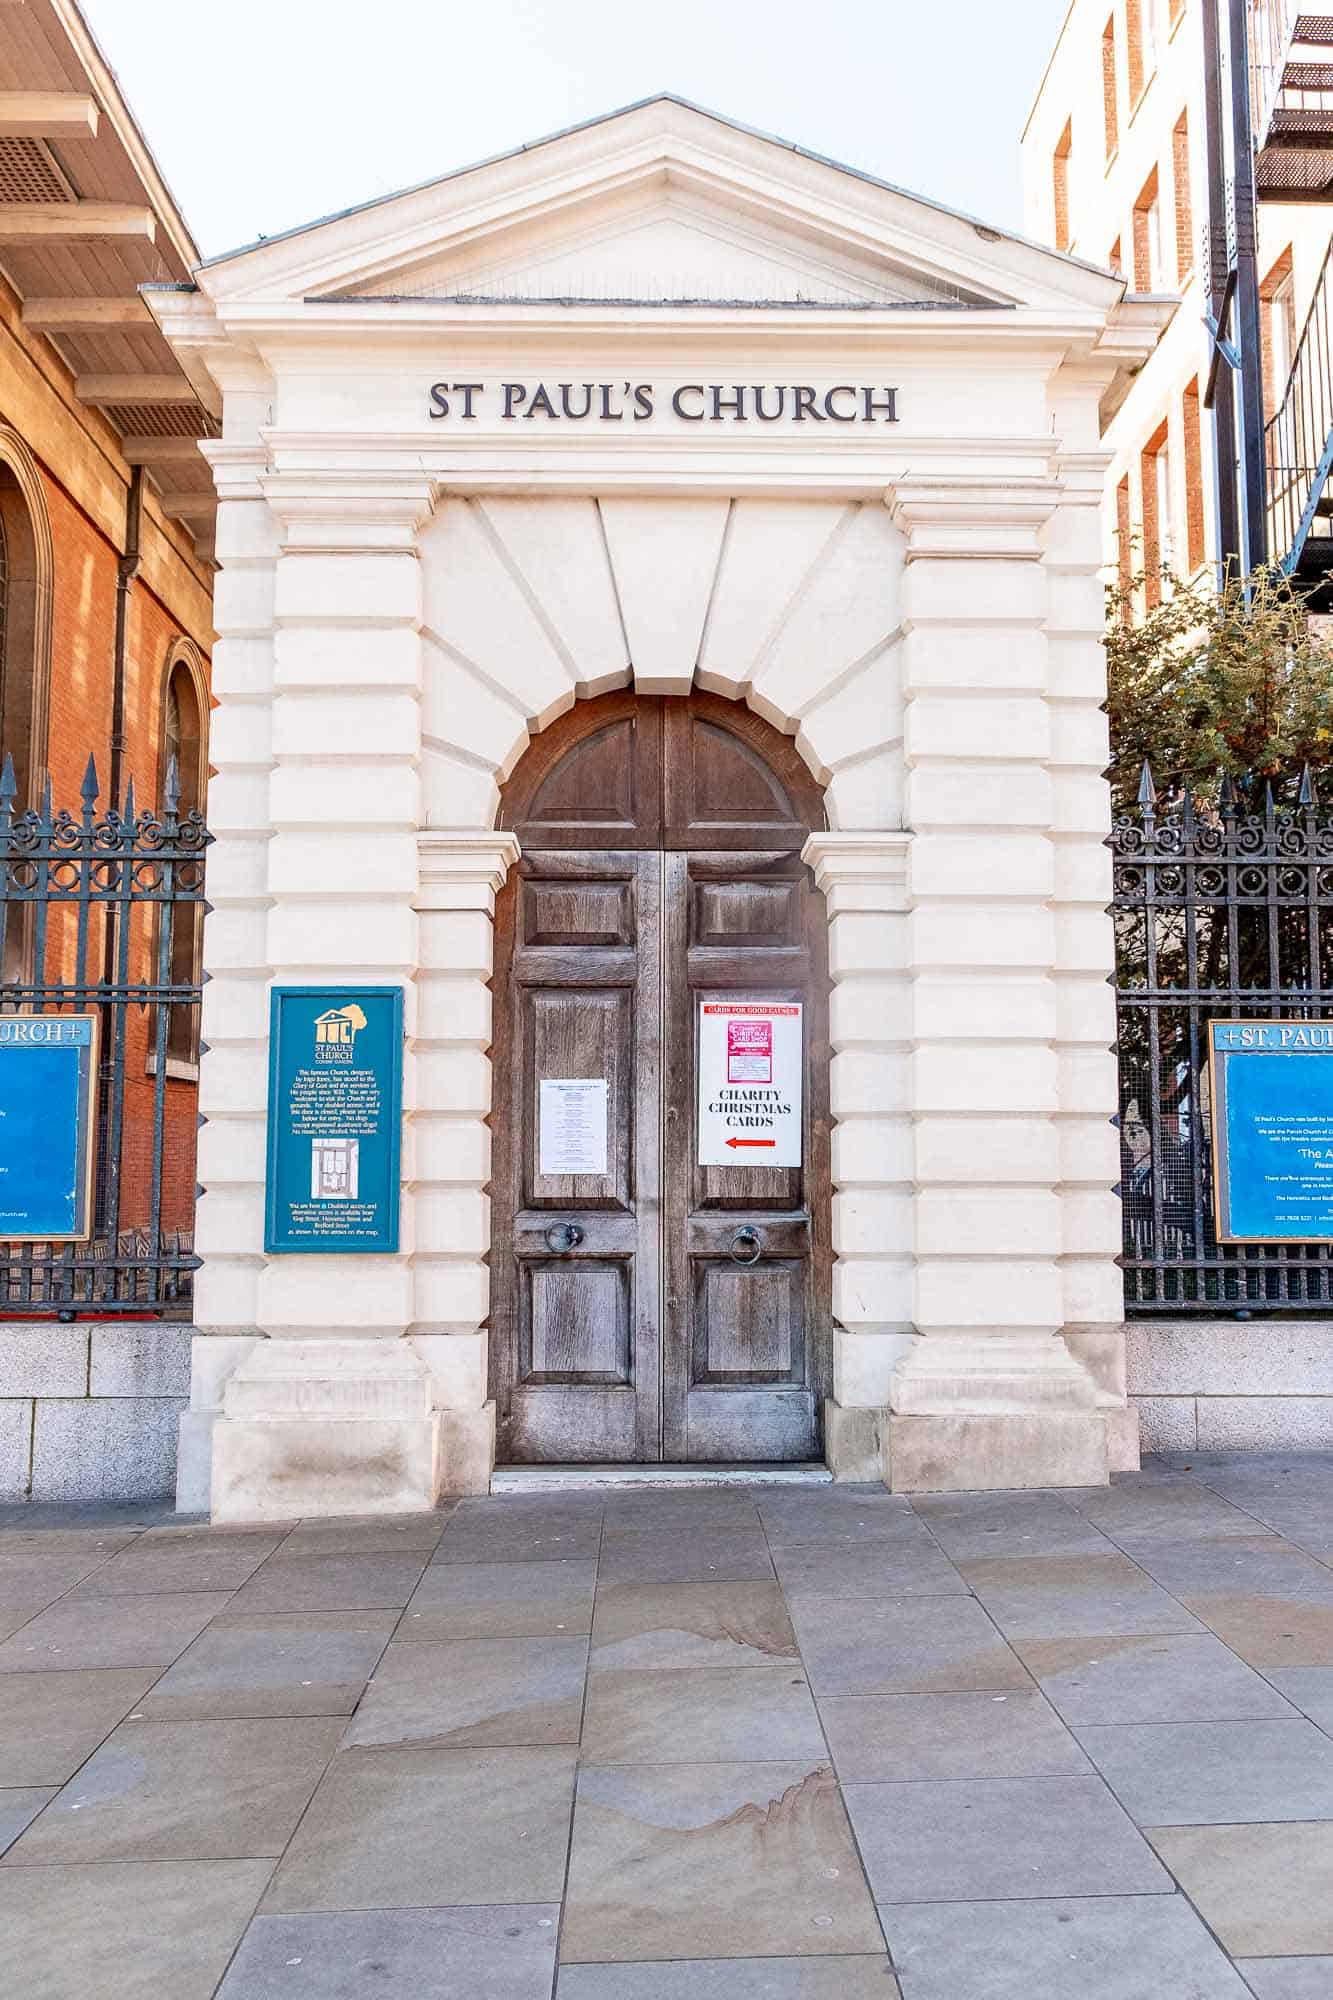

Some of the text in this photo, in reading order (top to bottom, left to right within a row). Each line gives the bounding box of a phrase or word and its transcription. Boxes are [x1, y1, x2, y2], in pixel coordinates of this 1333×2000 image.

[429, 381, 901, 422] ST PAUL'S CHURCH
[719, 1090, 782, 1101] CHARITY
[709, 1103, 791, 1114] CHRISTMAS
[726, 1116, 774, 1127] CARDS
